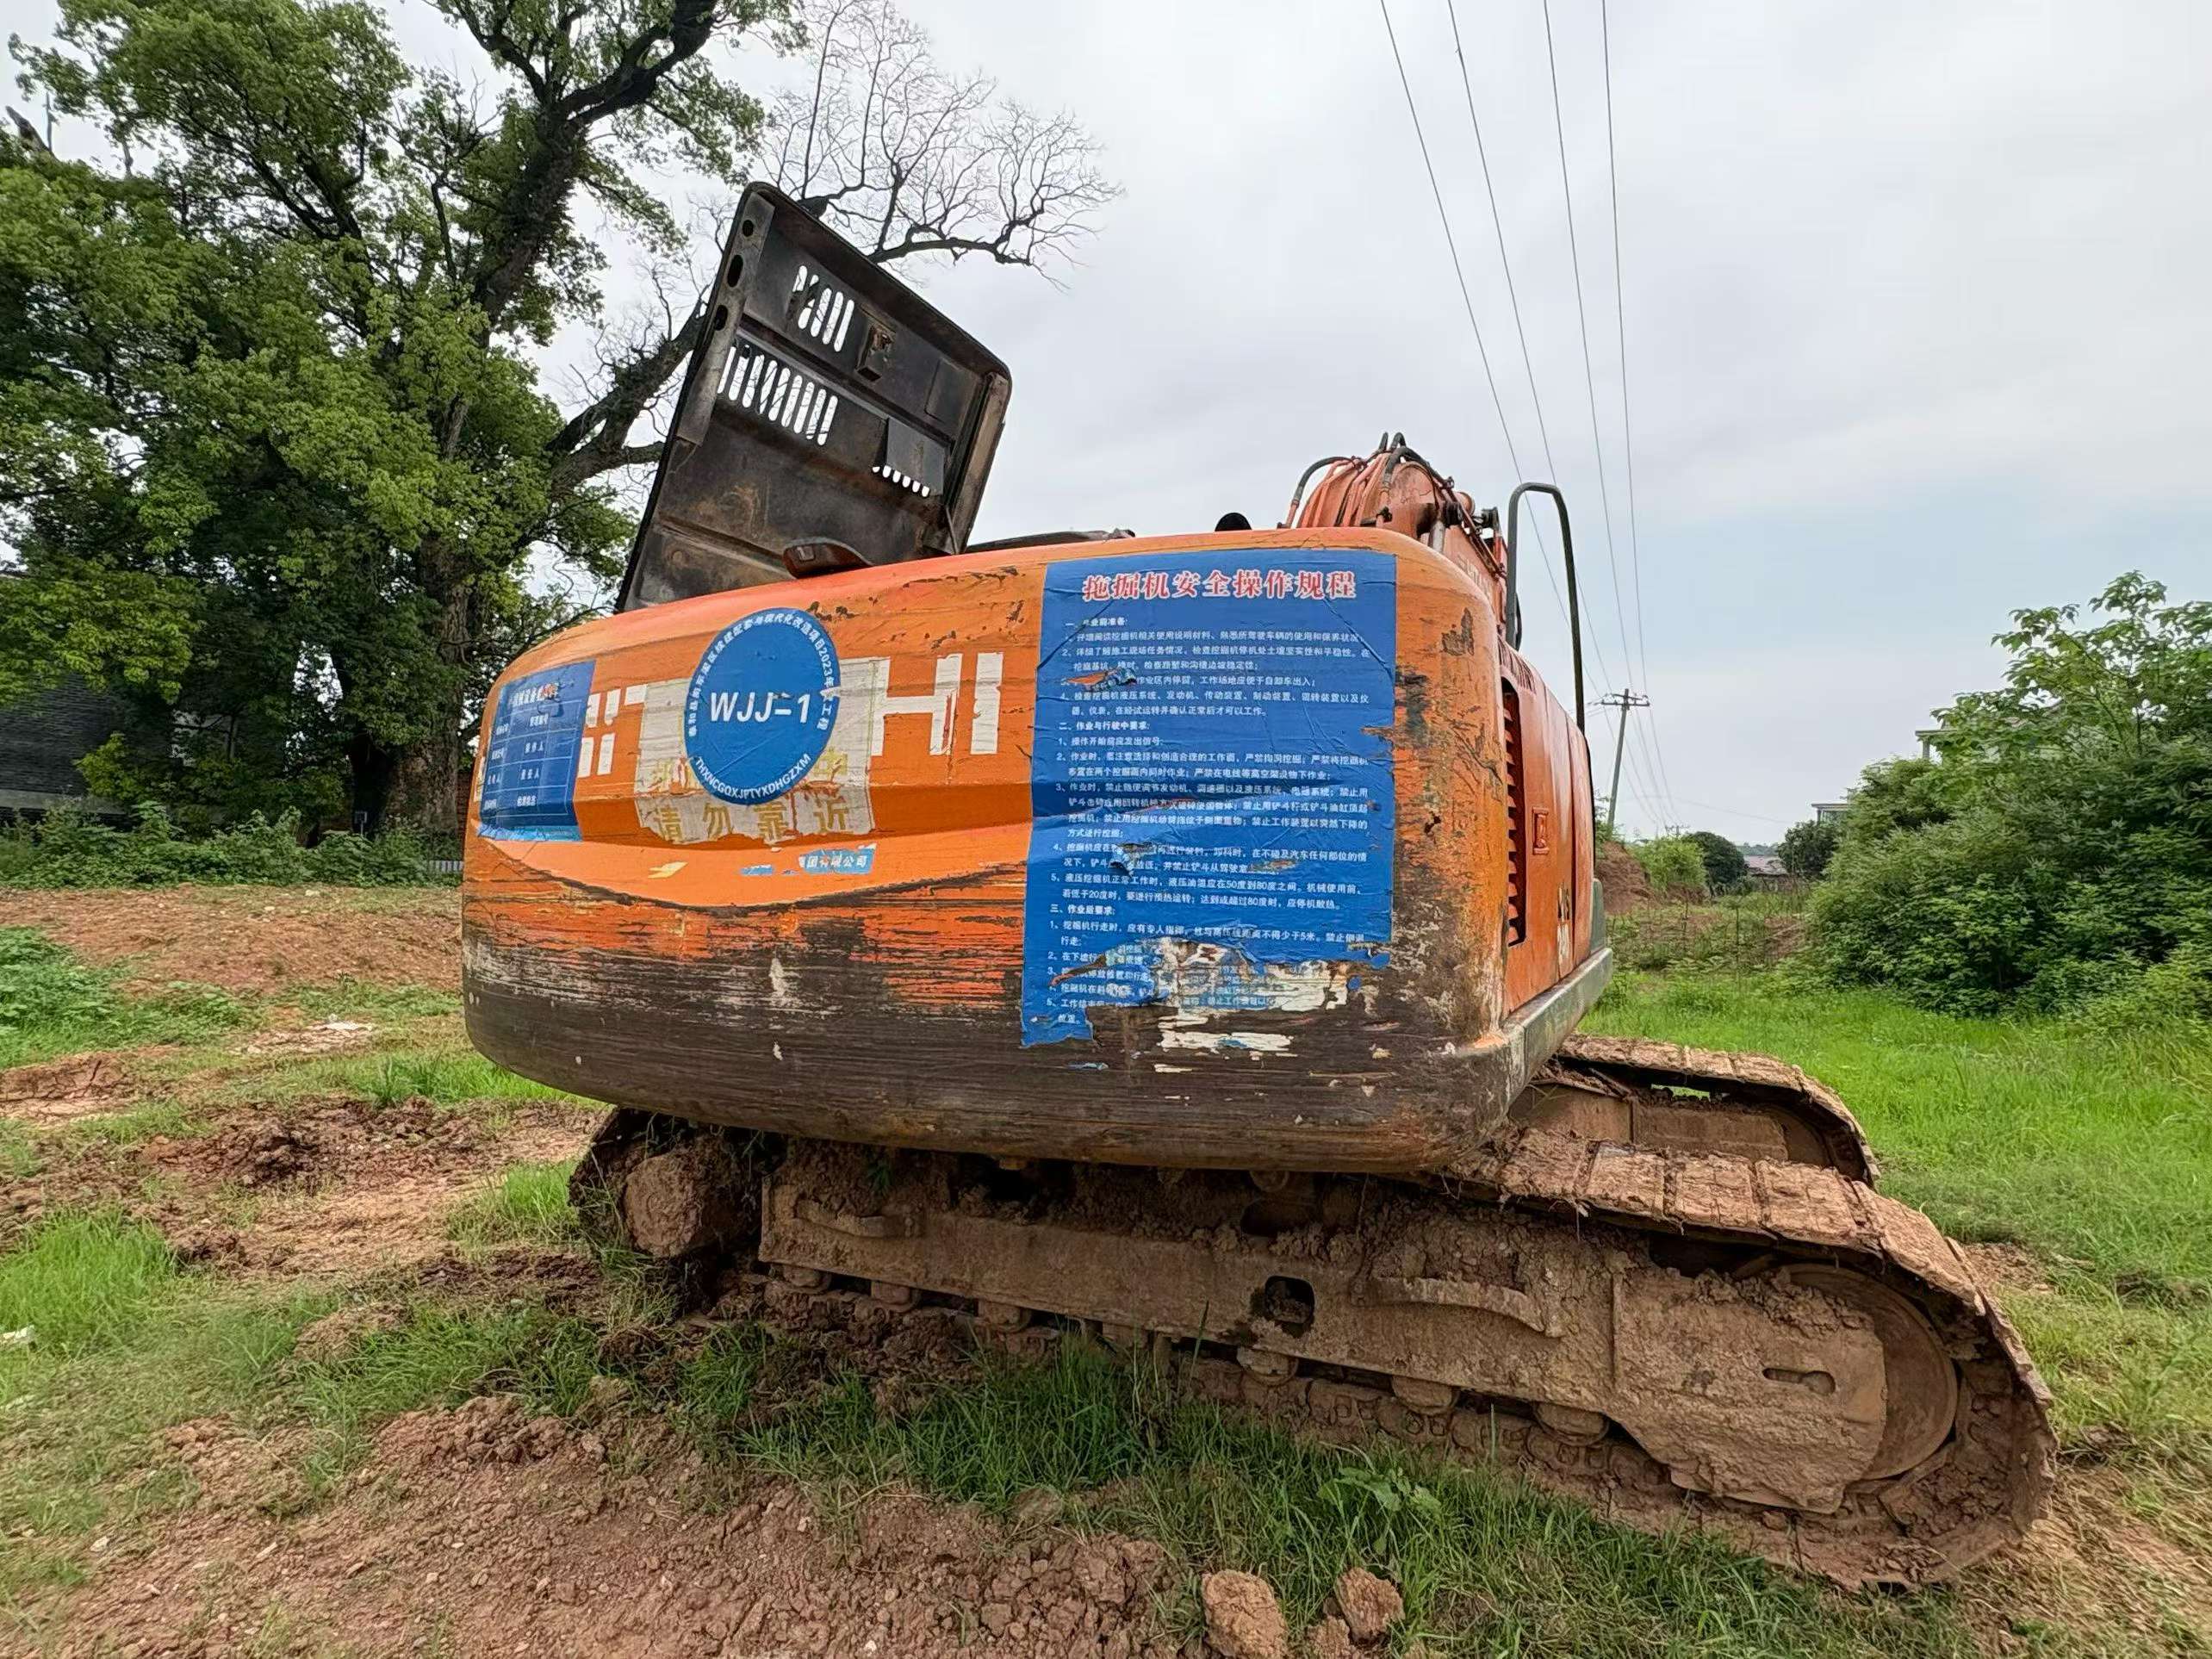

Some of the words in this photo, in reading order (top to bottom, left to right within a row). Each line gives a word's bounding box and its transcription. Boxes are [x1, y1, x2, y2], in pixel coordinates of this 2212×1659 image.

[1082, 569, 1357, 601] 挖掘机安全操作规程
[711, 692, 811, 724] WJJ-1
